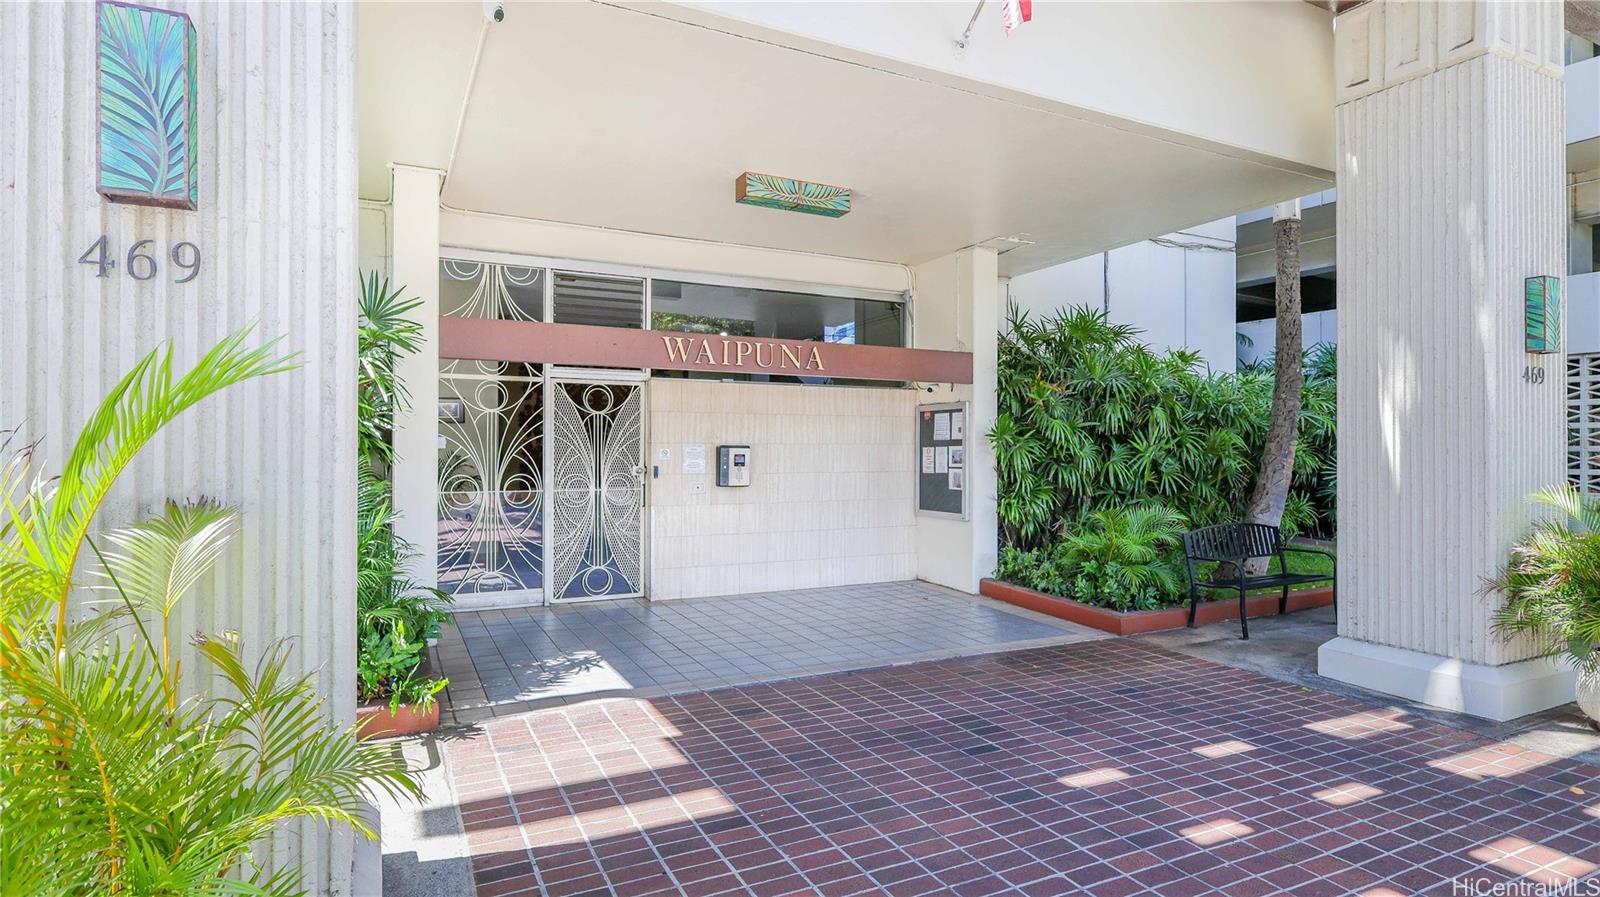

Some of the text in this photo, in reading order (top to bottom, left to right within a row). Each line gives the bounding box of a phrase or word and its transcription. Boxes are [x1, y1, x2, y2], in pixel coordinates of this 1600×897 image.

[78, 234, 201, 284] 469
[662, 336, 825, 371] WAIPUNA
[1522, 366, 1545, 384] 469
